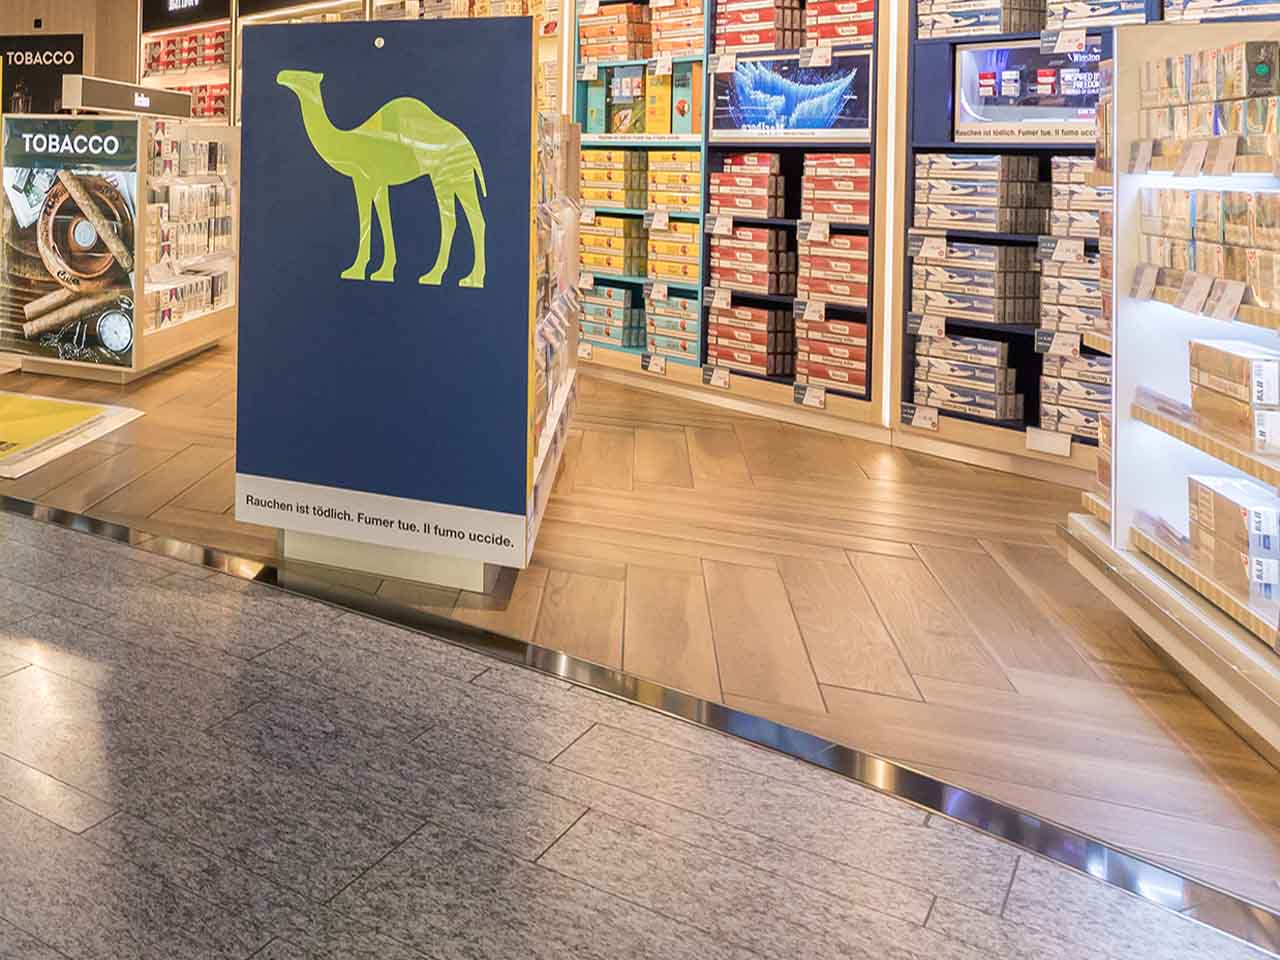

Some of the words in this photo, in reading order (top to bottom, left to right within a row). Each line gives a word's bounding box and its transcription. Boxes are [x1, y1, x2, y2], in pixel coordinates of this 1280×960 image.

[6, 50, 75, 65] TOBACCO
[22, 133, 120, 155] TOBACCO
[246, 494, 293, 512] Rauchen
[296, 503, 310, 515] ist
[312, 505, 355, 522] tödlich.
[357, 512, 395, 529] Fumer
[398, 519, 420, 533] tue.
[423, 522, 431, 535] Il
[433, 525, 465, 540] fumo
[469, 532, 515, 548] uccide.
